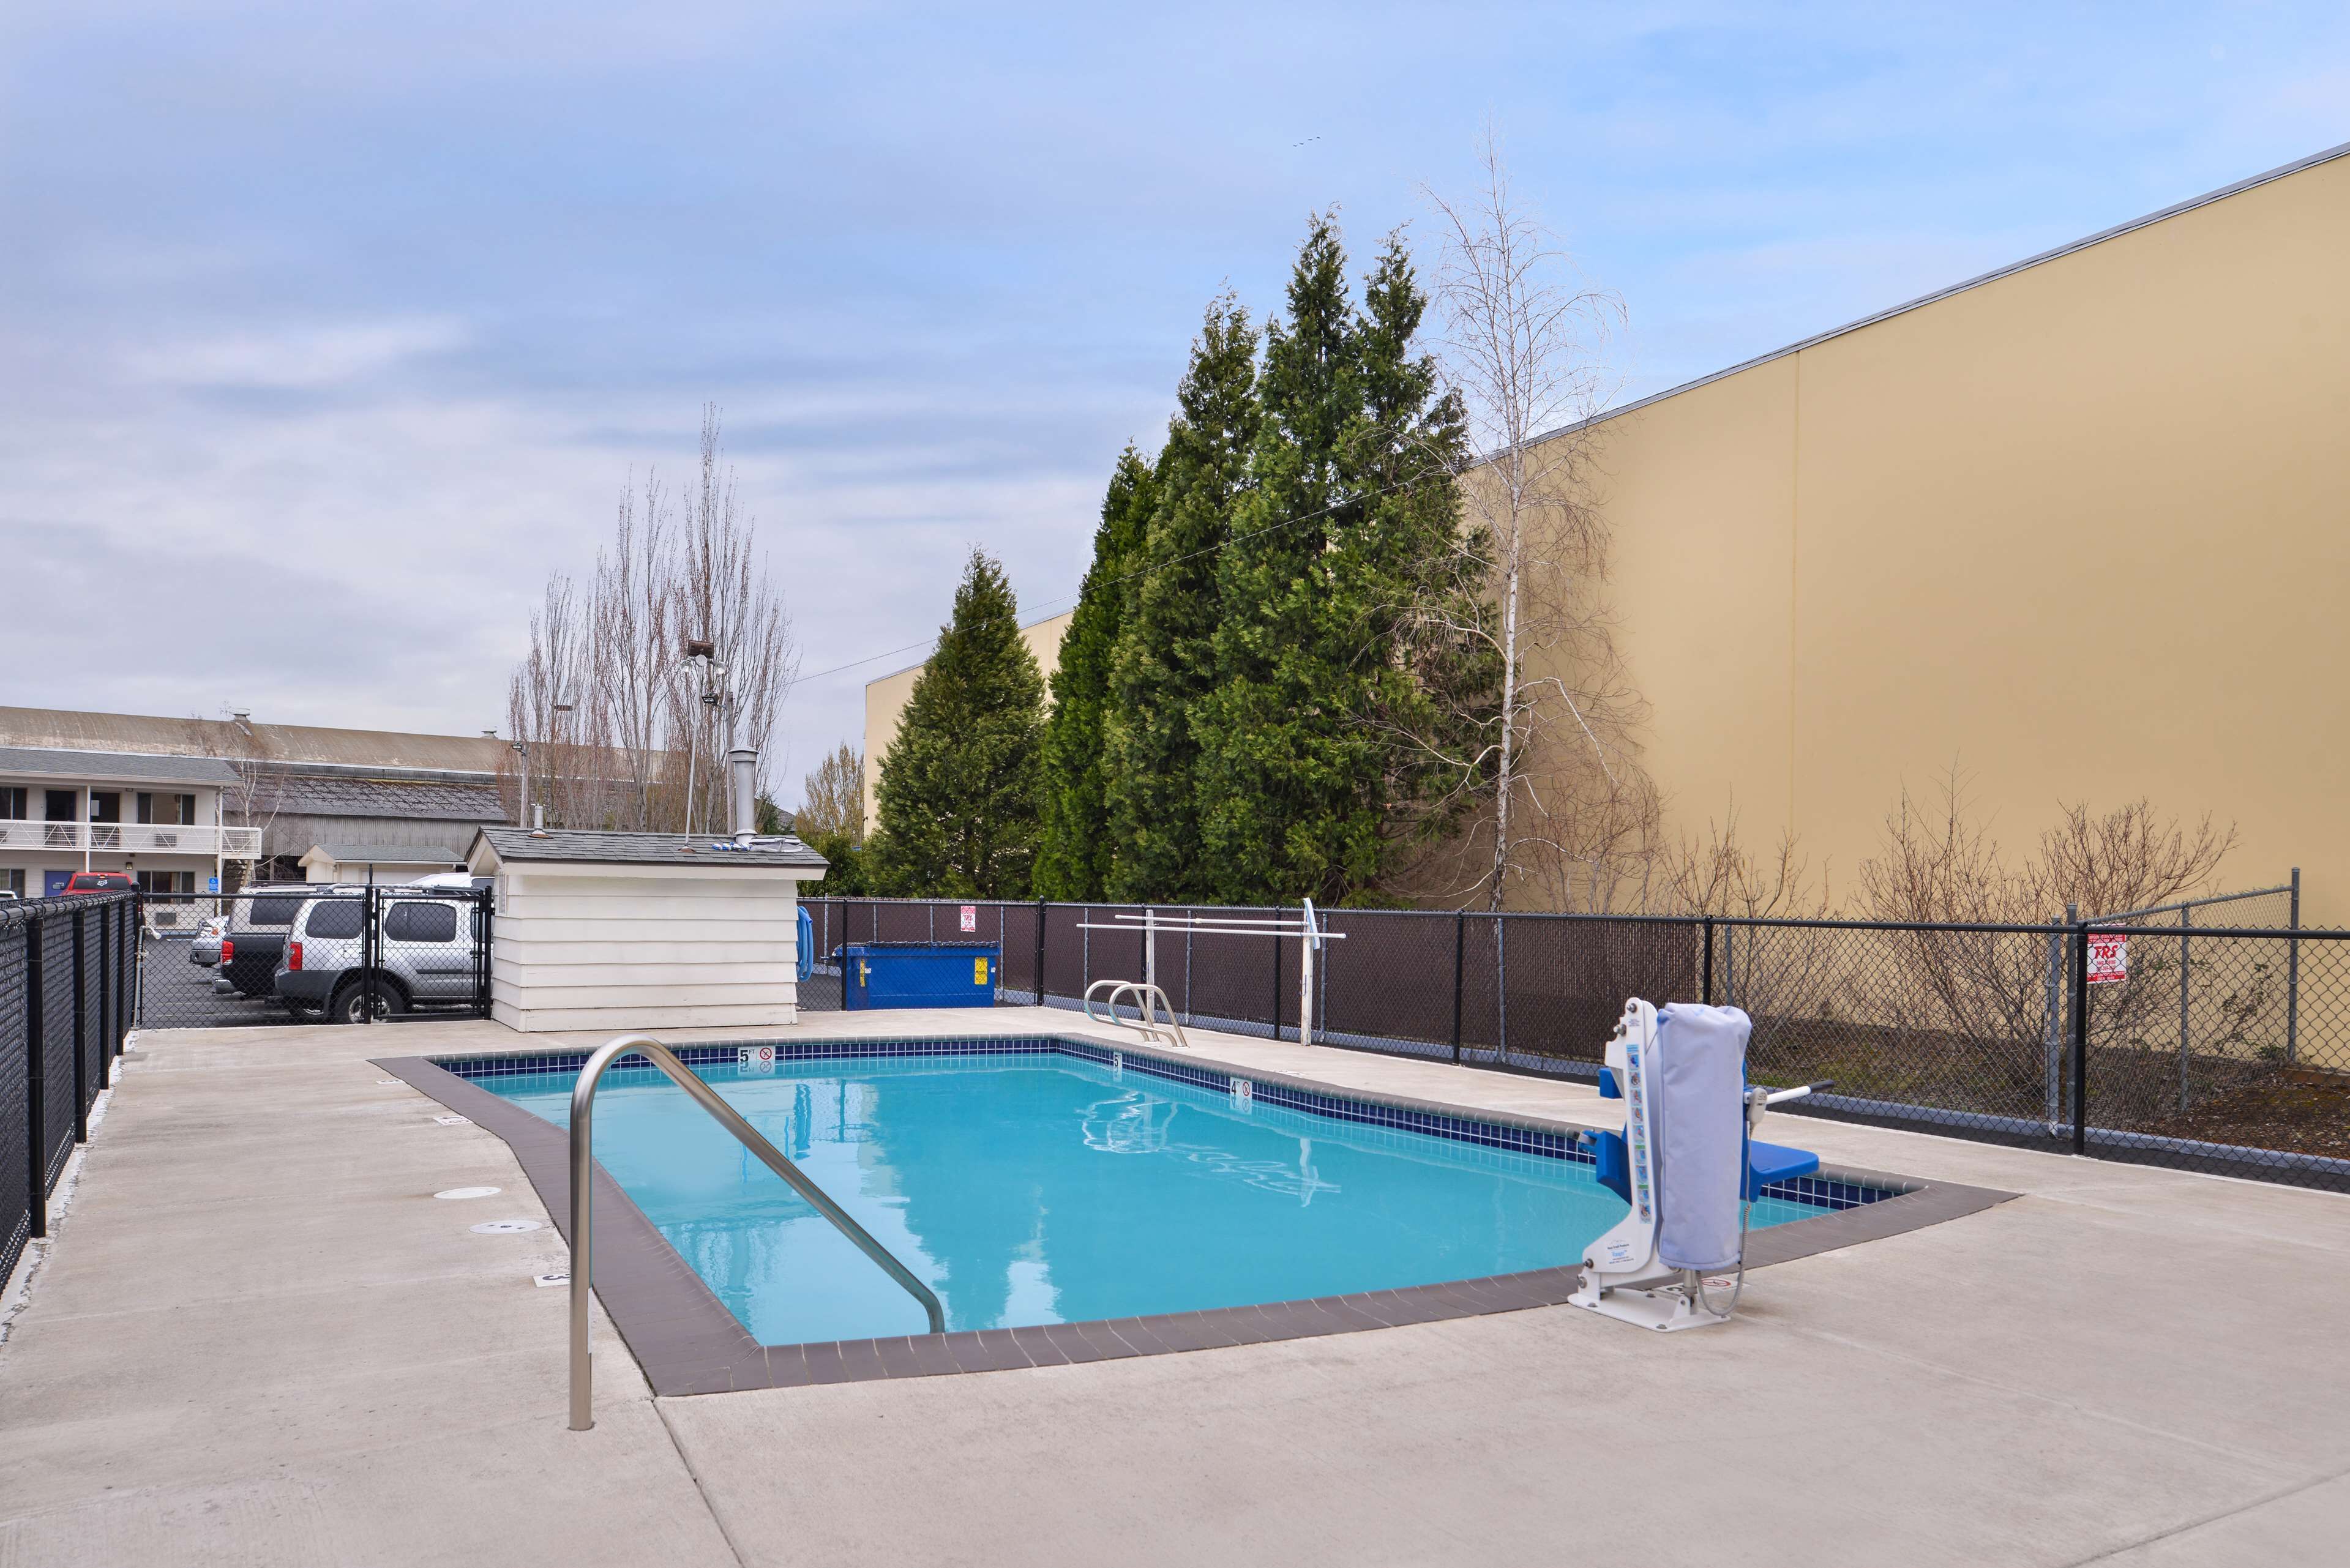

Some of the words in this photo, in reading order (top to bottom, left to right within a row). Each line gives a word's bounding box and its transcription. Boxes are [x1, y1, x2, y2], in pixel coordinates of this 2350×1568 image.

[2094, 944, 2119, 960] TRS
[740, 1050, 748, 1062] 5
[1114, 1055, 1118, 1067] 5
[1231, 1081, 1237, 1095] 4
